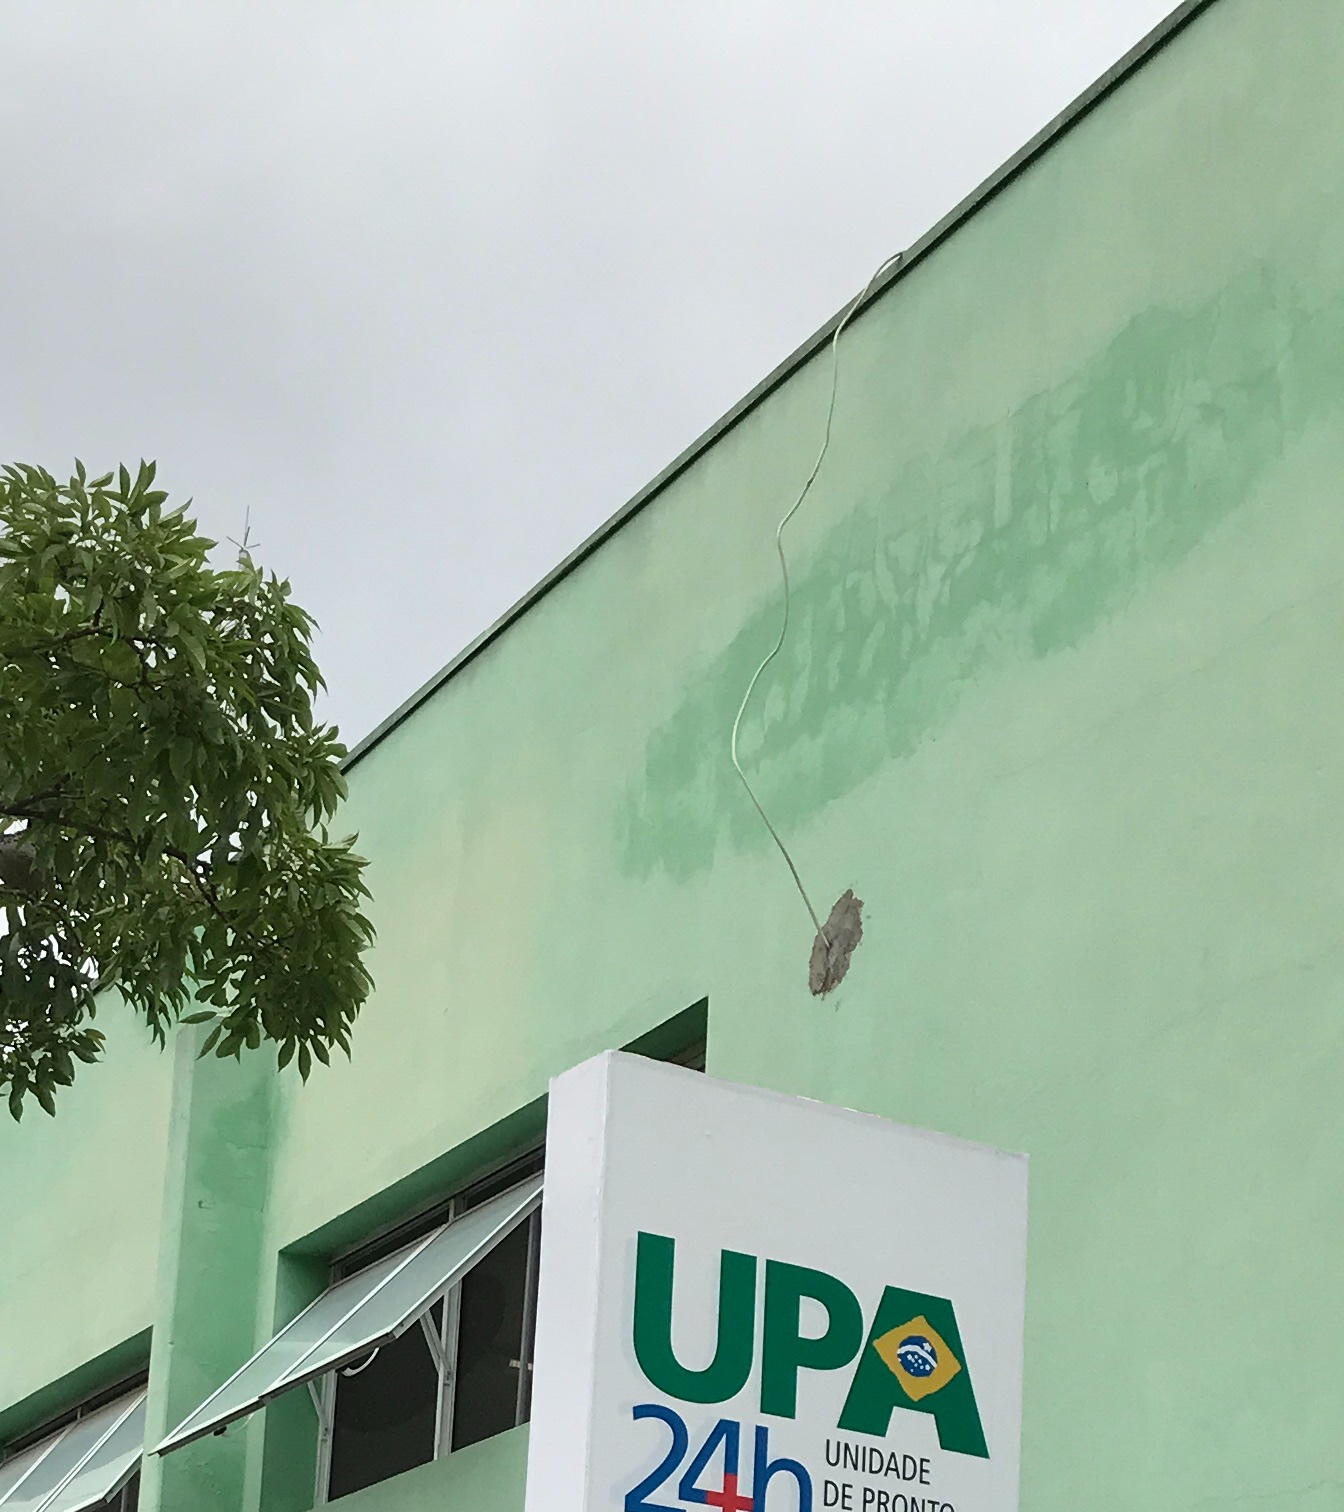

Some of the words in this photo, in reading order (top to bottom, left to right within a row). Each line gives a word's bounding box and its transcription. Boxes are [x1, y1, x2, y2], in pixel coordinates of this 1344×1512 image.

[632, 1230, 990, 1460] UPA
[824, 1438, 931, 1485] UNIDADE
[822, 1479, 854, 1511] DE
